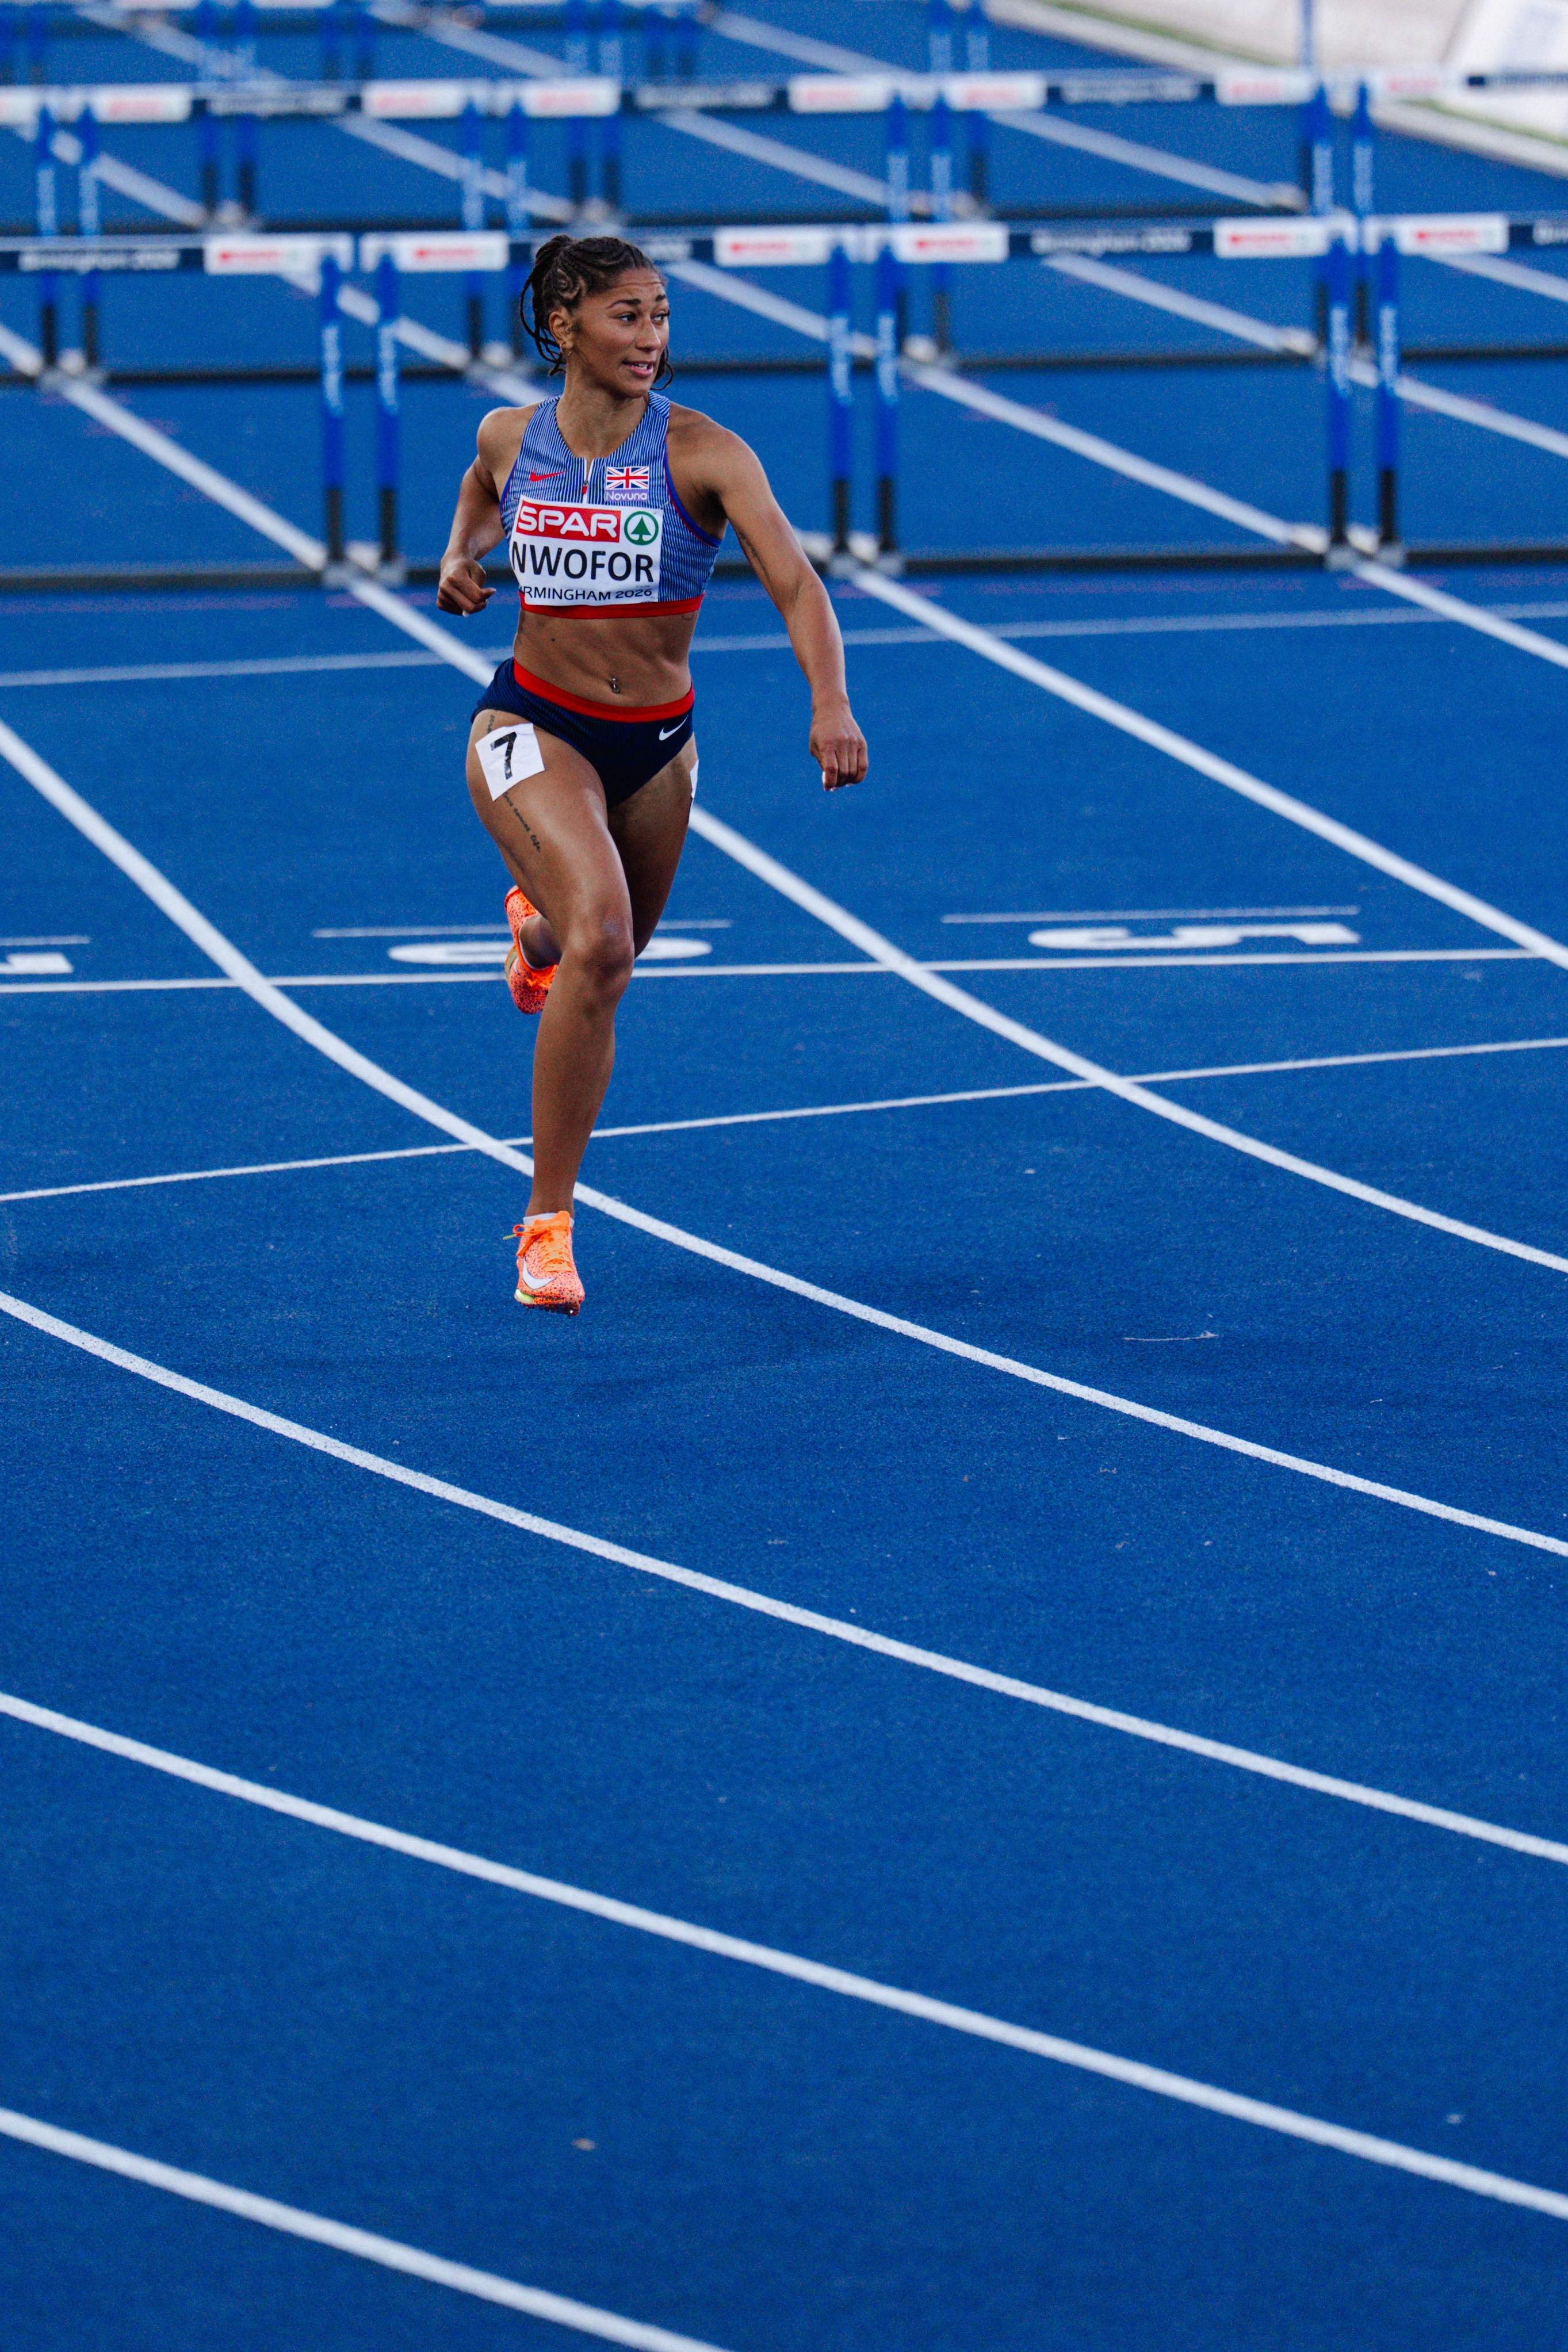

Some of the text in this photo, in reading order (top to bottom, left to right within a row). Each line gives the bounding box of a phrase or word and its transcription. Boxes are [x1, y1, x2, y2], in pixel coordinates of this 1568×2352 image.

[606, 491, 648, 501] Novuna
[518, 506, 618, 538] SPAR
[512, 541, 654, 583] NWOFOR
[519, 586, 653, 601] RMINGHAM 2026
[490, 731, 518, 781] 7
